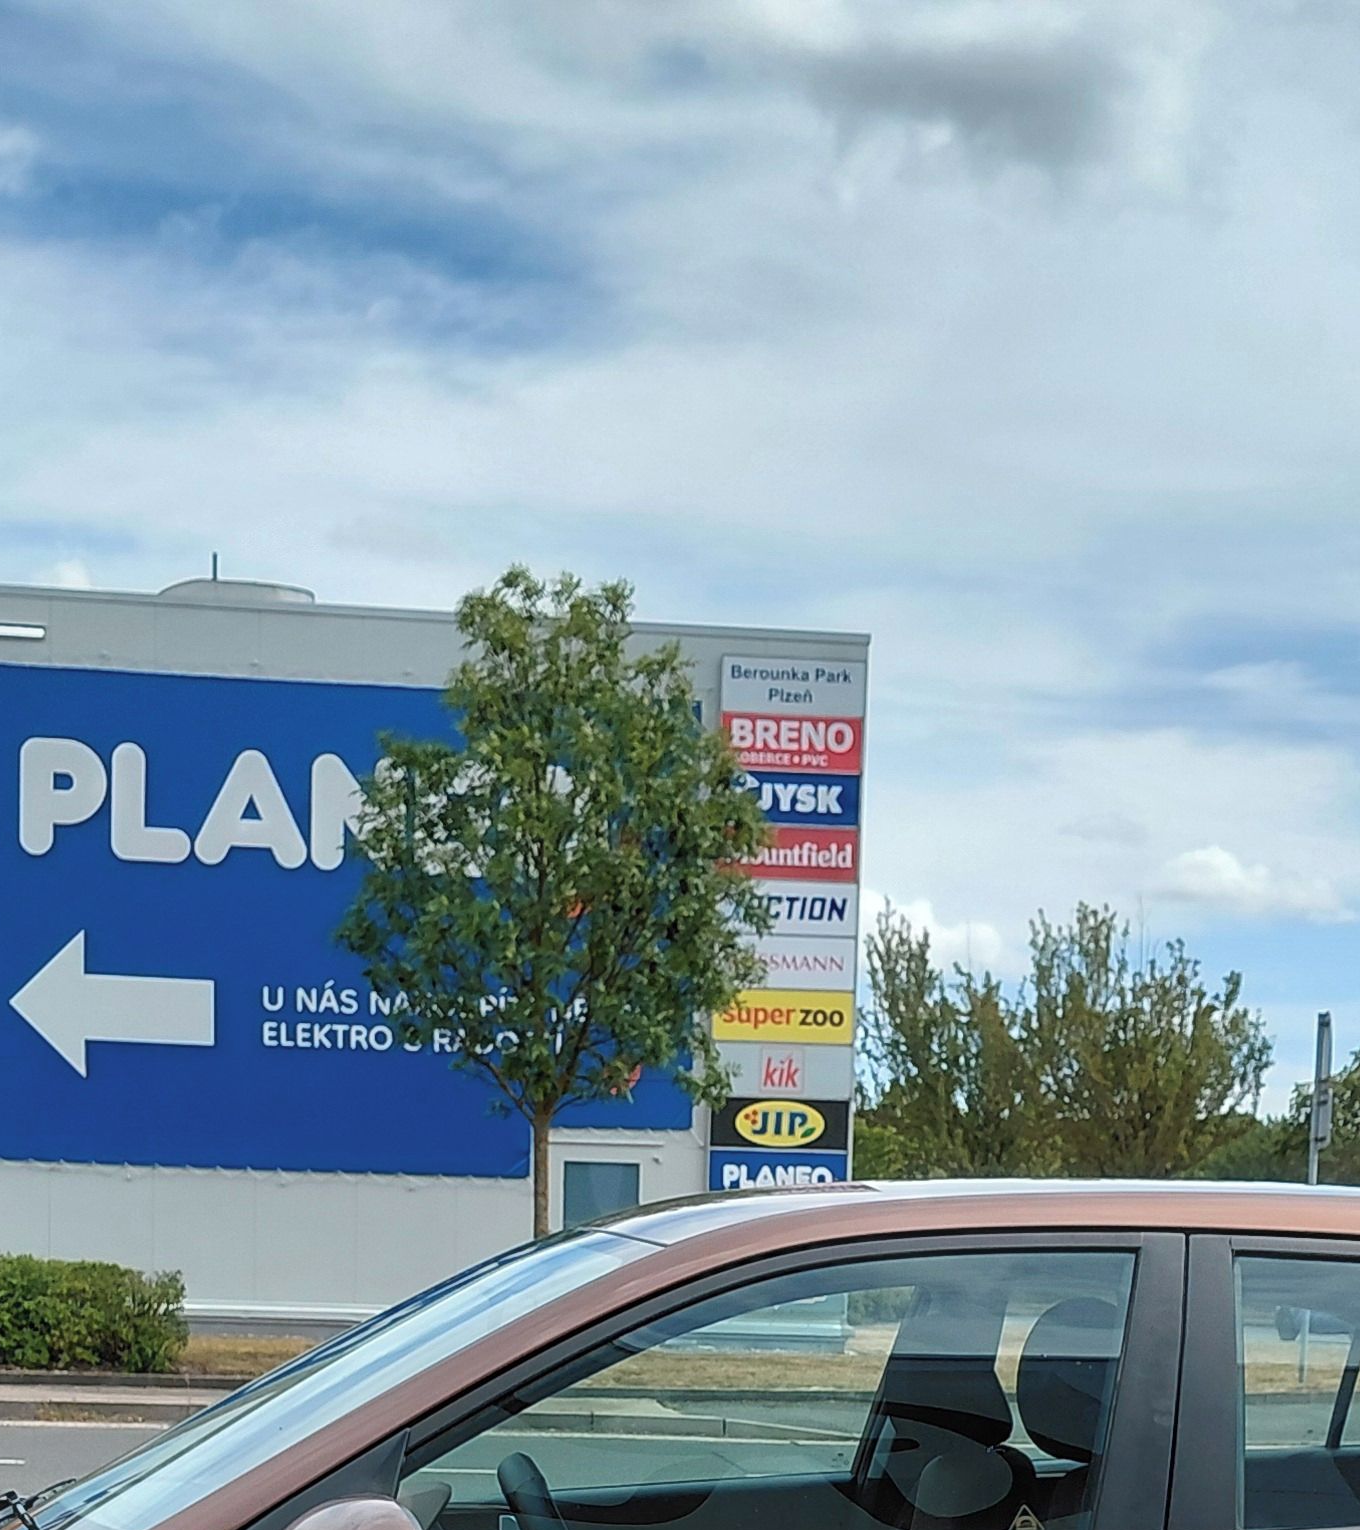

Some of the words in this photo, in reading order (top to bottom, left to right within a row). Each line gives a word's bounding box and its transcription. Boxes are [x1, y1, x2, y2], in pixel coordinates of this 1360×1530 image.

[731, 664, 810, 682] Berounka
[815, 667, 852, 684] Park
[768, 688, 813, 704] Plzeň
[731, 717, 854, 754] BRENO
[801, 754, 829, 767] PVC
[757, 782, 843, 814] JYSK
[745, 895, 847, 922] CTION
[262, 985, 283, 1011] U
[296, 979, 358, 1015] NÁS
[722, 1005, 796, 1030] super
[799, 1008, 845, 1027] zoo
[262, 1021, 393, 1051] ELEKTRO
[752, 1111, 808, 1137] JIP
